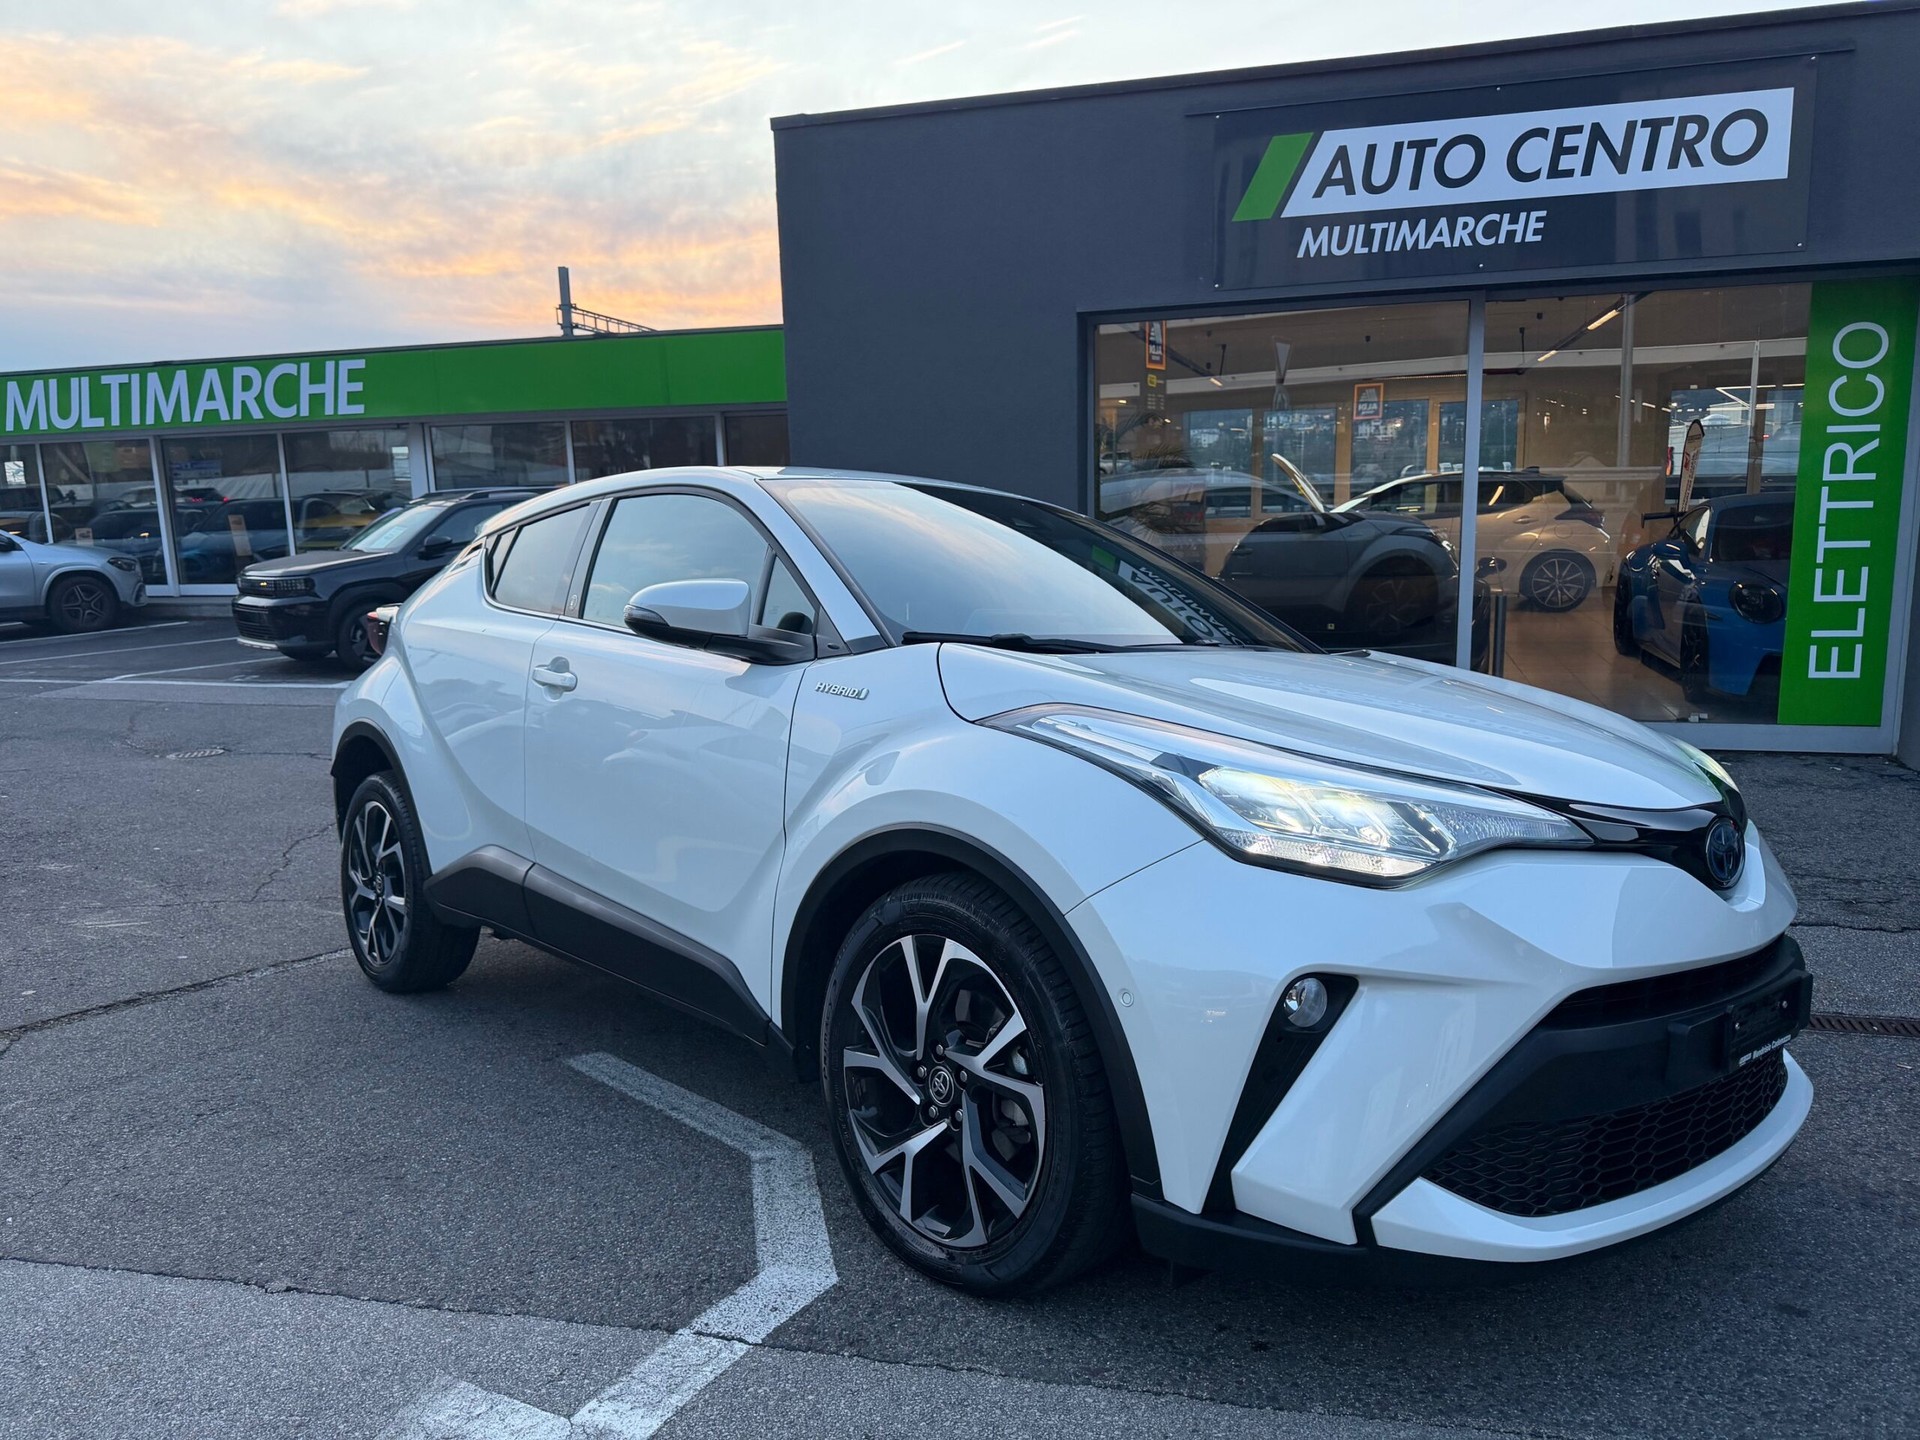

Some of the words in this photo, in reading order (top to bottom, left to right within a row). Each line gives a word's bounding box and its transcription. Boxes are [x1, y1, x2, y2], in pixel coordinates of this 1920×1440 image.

[1312, 134, 1486, 199] AUTO
[1505, 108, 1769, 184] CENTRO
[1297, 211, 1547, 259] MULTIMARCHE
[5, 358, 366, 432] MULTIMARCHE
[1808, 321, 1890, 679] ELETTRICO
[815, 681, 859, 698] HYBRID
